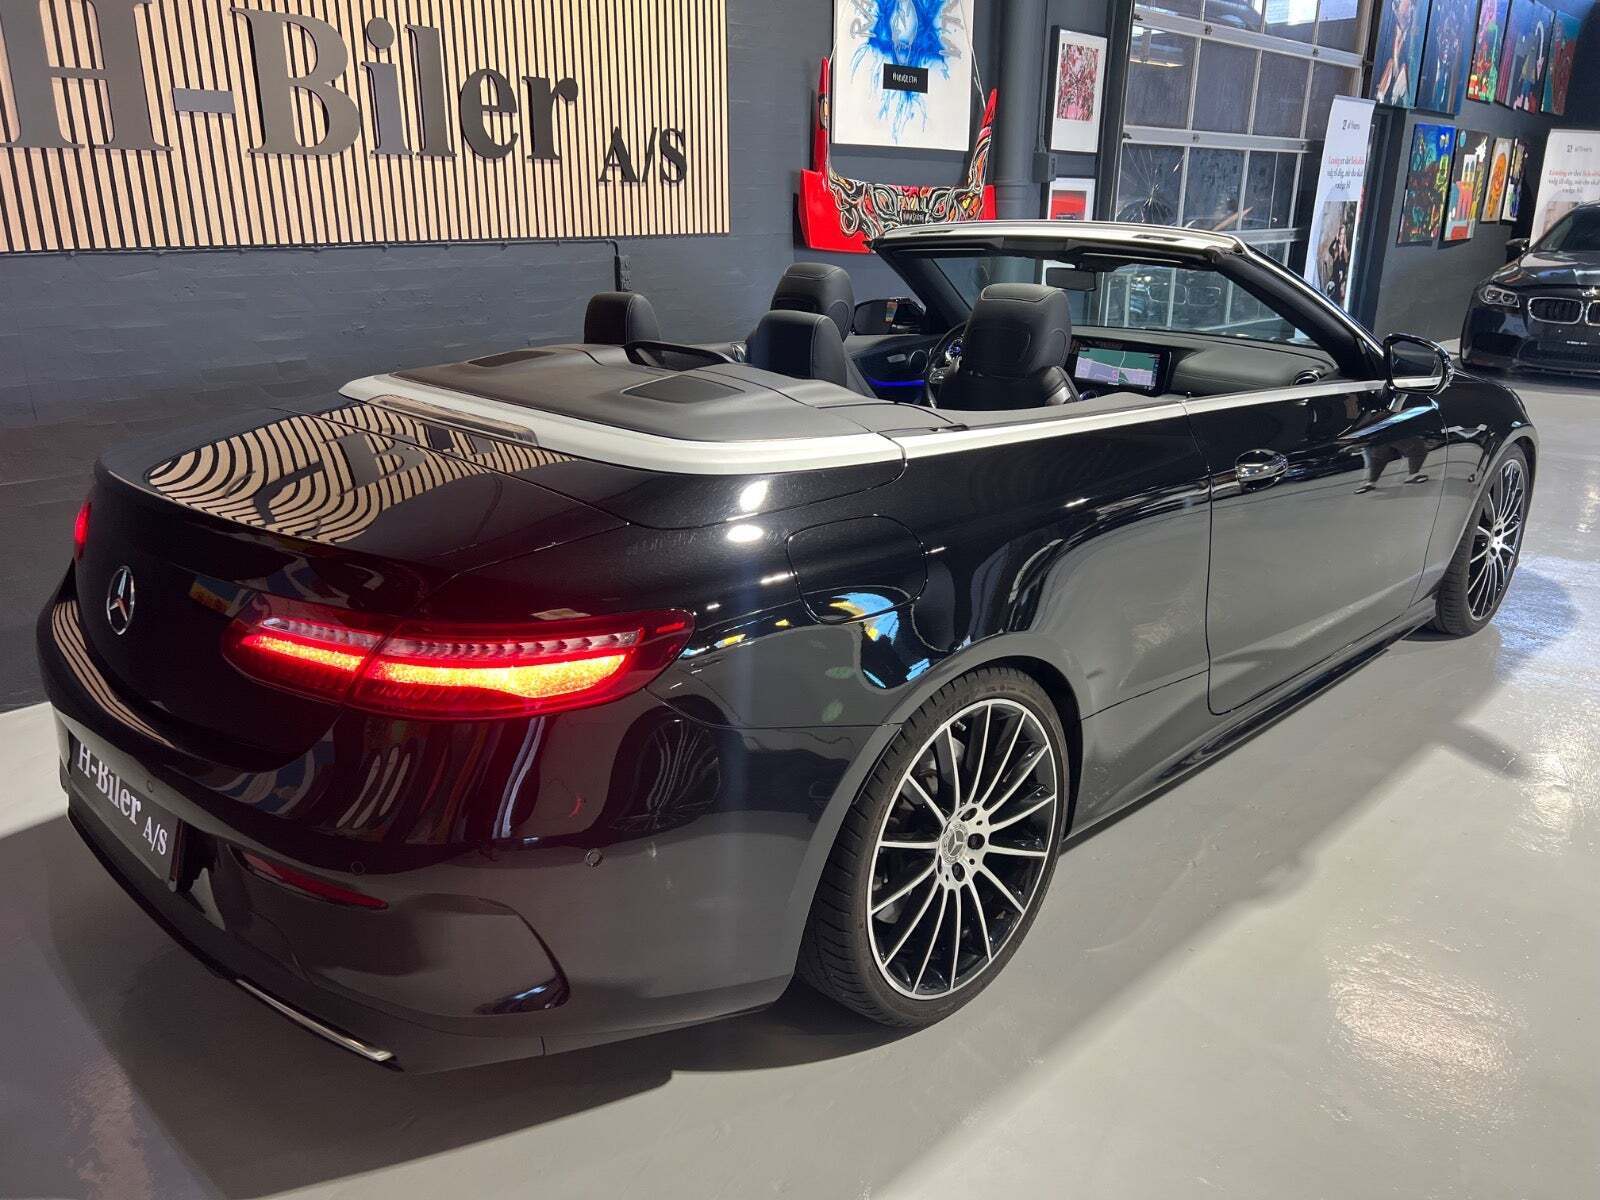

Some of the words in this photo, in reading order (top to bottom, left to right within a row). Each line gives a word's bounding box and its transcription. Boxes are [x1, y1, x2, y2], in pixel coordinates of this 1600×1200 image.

[0, 0, 578, 159] H-Biler
[597, 126, 687, 184] A/S
[77, 743, 141, 825] H-Biler
[142, 816, 168, 855] A/S
